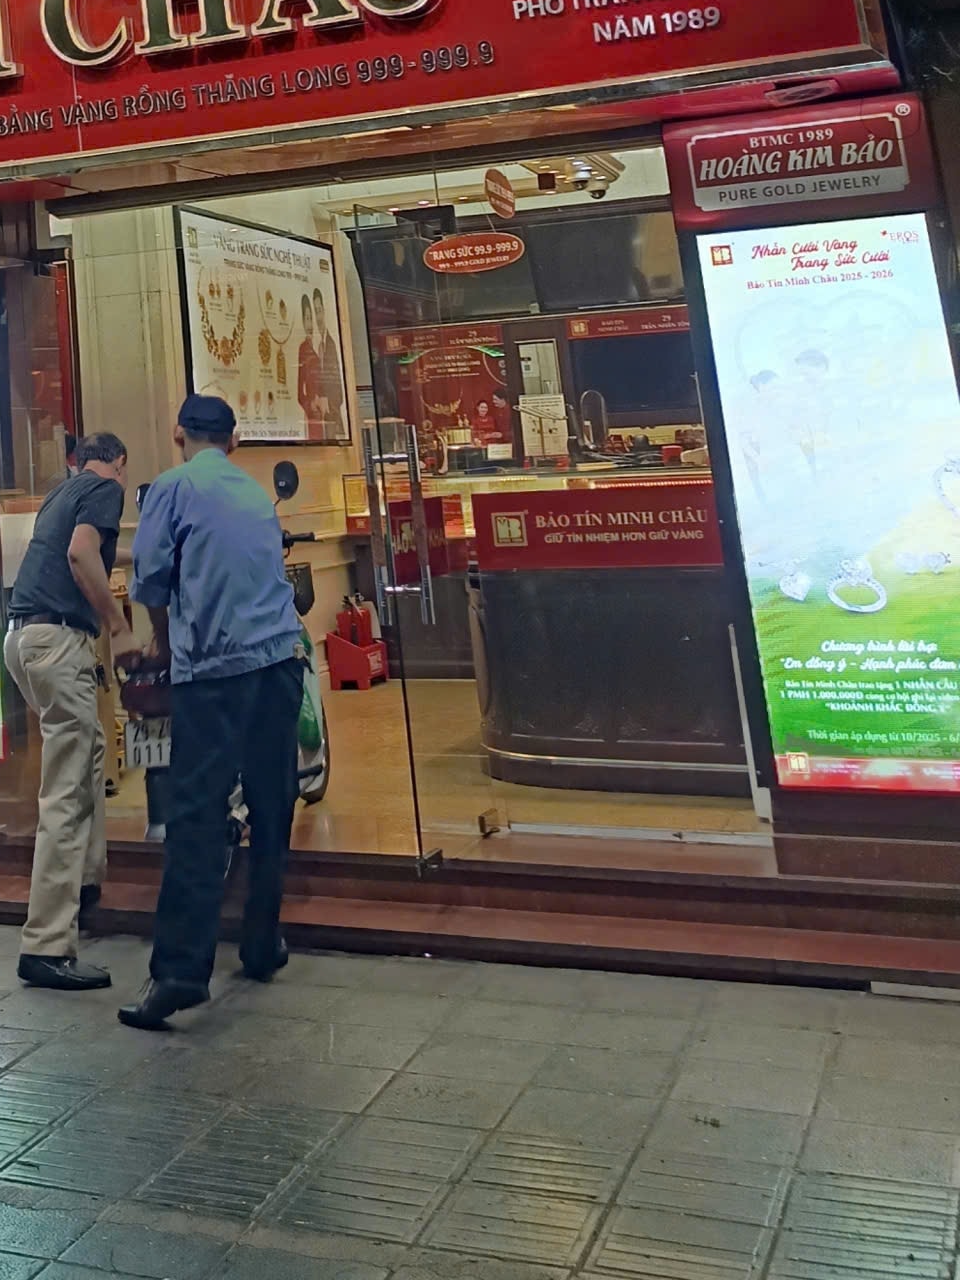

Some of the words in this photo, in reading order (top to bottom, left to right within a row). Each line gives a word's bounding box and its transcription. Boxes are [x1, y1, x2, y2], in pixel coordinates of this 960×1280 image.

[592, 14, 655, 43] NĂM
[661, 6, 721, 34] 1989
[61, 94, 118, 125] VÀNG
[123, 85, 186, 117] RỒNG
[191, 74, 275, 107] THĂNG
[281, 63, 350, 94] LONG
[749, 133, 795, 150] BTMC
[798, 128, 835, 144] 1989
[699, 149, 783, 182] HOÀNG
[786, 143, 835, 172] KIM
[840, 133, 895, 166] BẢO
[718, 186, 758, 203] PURE
[762, 182, 807, 198] GOLD
[811, 174, 882, 194] JEWELRY
[840, 271, 863, 282] 2025
[871, 269, 894, 280] 2026
[536, 511, 570, 528] BẢO
[573, 509, 602, 526] TÍN
[607, 510, 654, 526] MINH
[657, 506, 708, 524] CHÂU
[566, 532, 584, 543] TÍN
[585, 531, 620, 544] NHIỆM
[621, 530, 647, 542] HƠN
[671, 528, 704, 540] VÀNG
